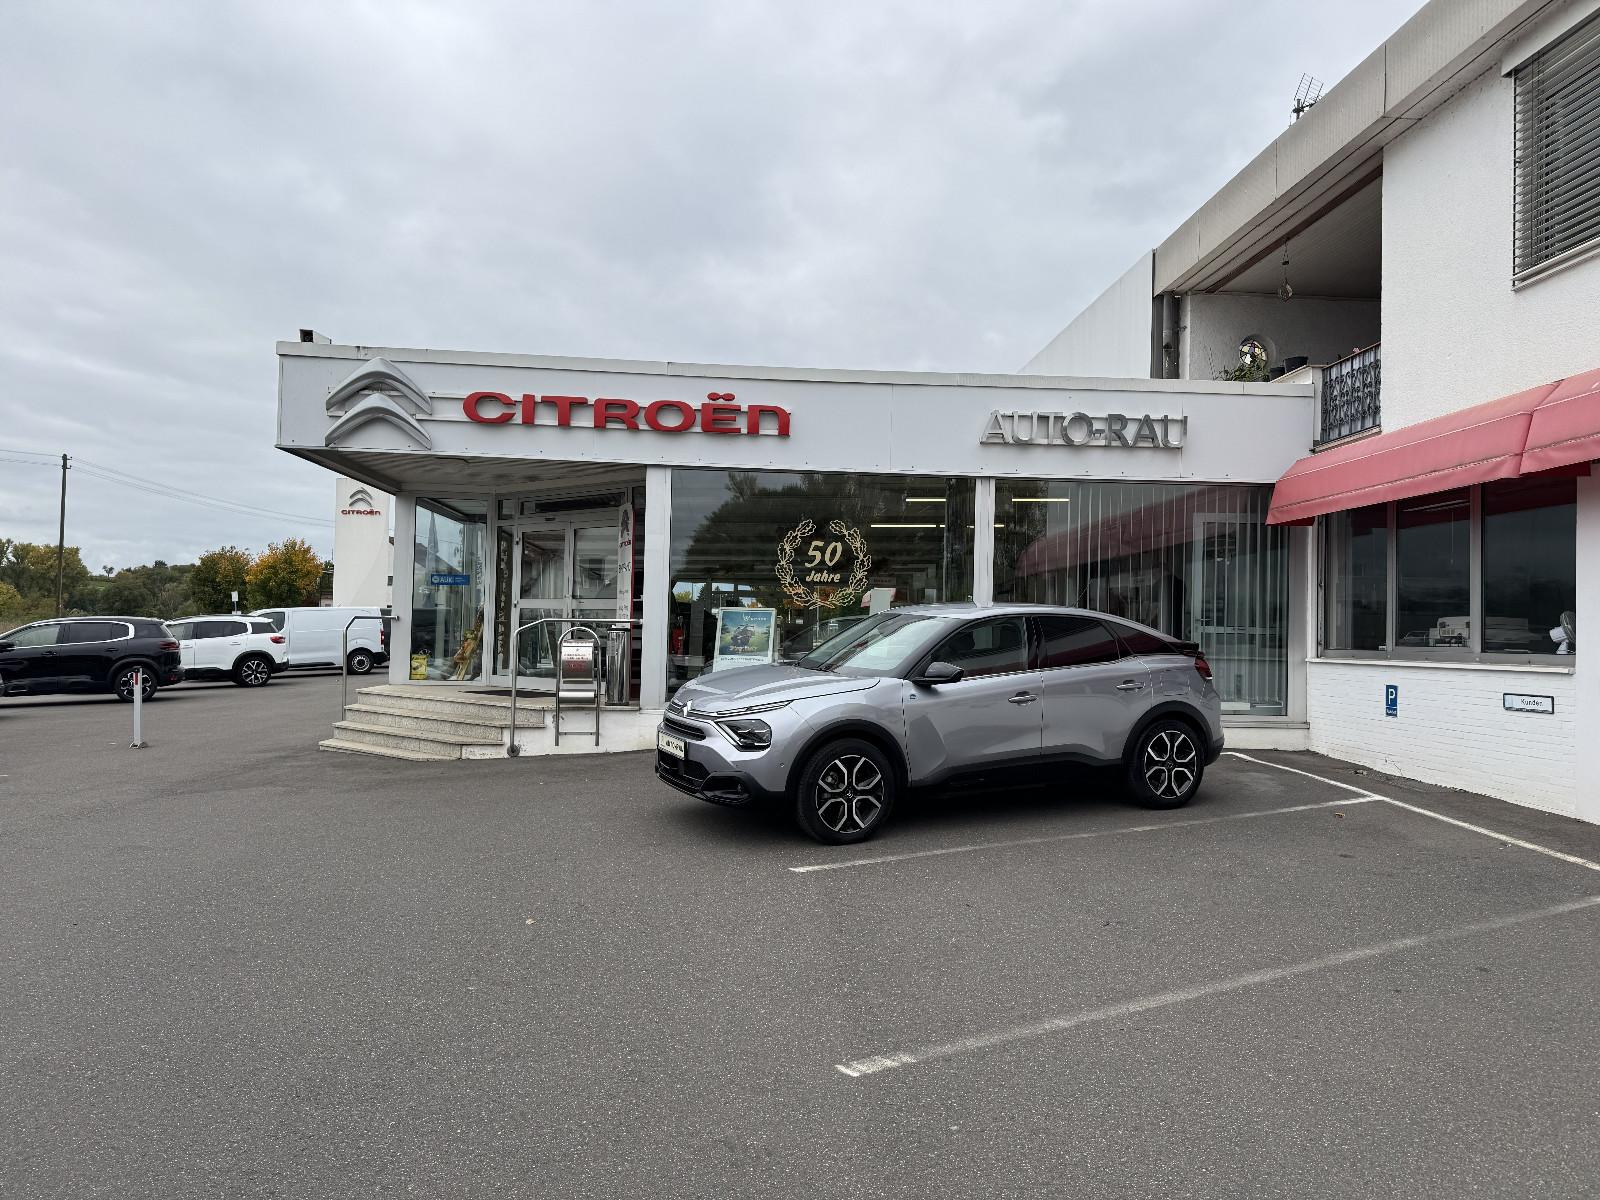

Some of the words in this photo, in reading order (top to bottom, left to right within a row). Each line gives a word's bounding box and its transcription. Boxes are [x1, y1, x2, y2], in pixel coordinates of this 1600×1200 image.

[979, 410, 1188, 449] AUTO-RAU
[805, 541, 842, 567] 50
[806, 570, 841, 583] Jahre
[1388, 689, 1396, 705] P
